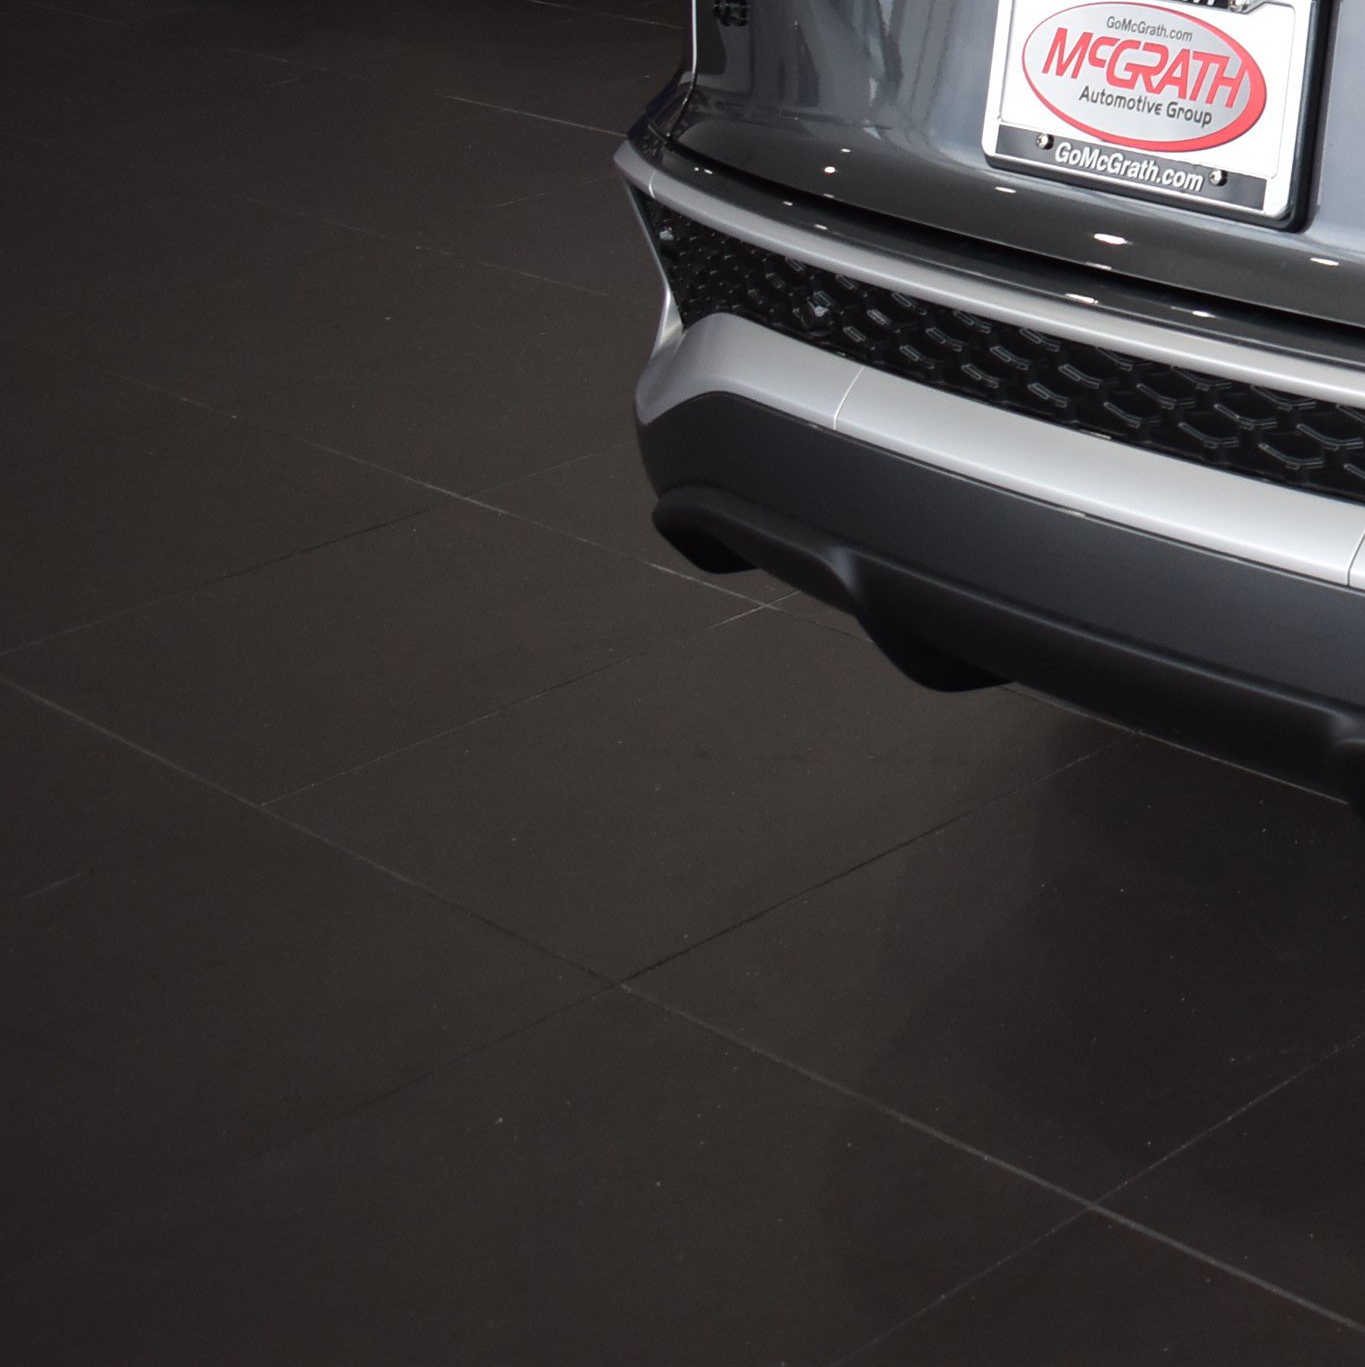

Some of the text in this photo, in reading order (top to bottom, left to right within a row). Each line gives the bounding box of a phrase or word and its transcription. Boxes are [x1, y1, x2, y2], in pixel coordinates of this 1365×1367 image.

[1106, 15, 1193, 42] GoMcGrath.com
[1079, 85, 1213, 129] Automotive Group
[1054, 141, 1205, 192] GoMcGrath.com
